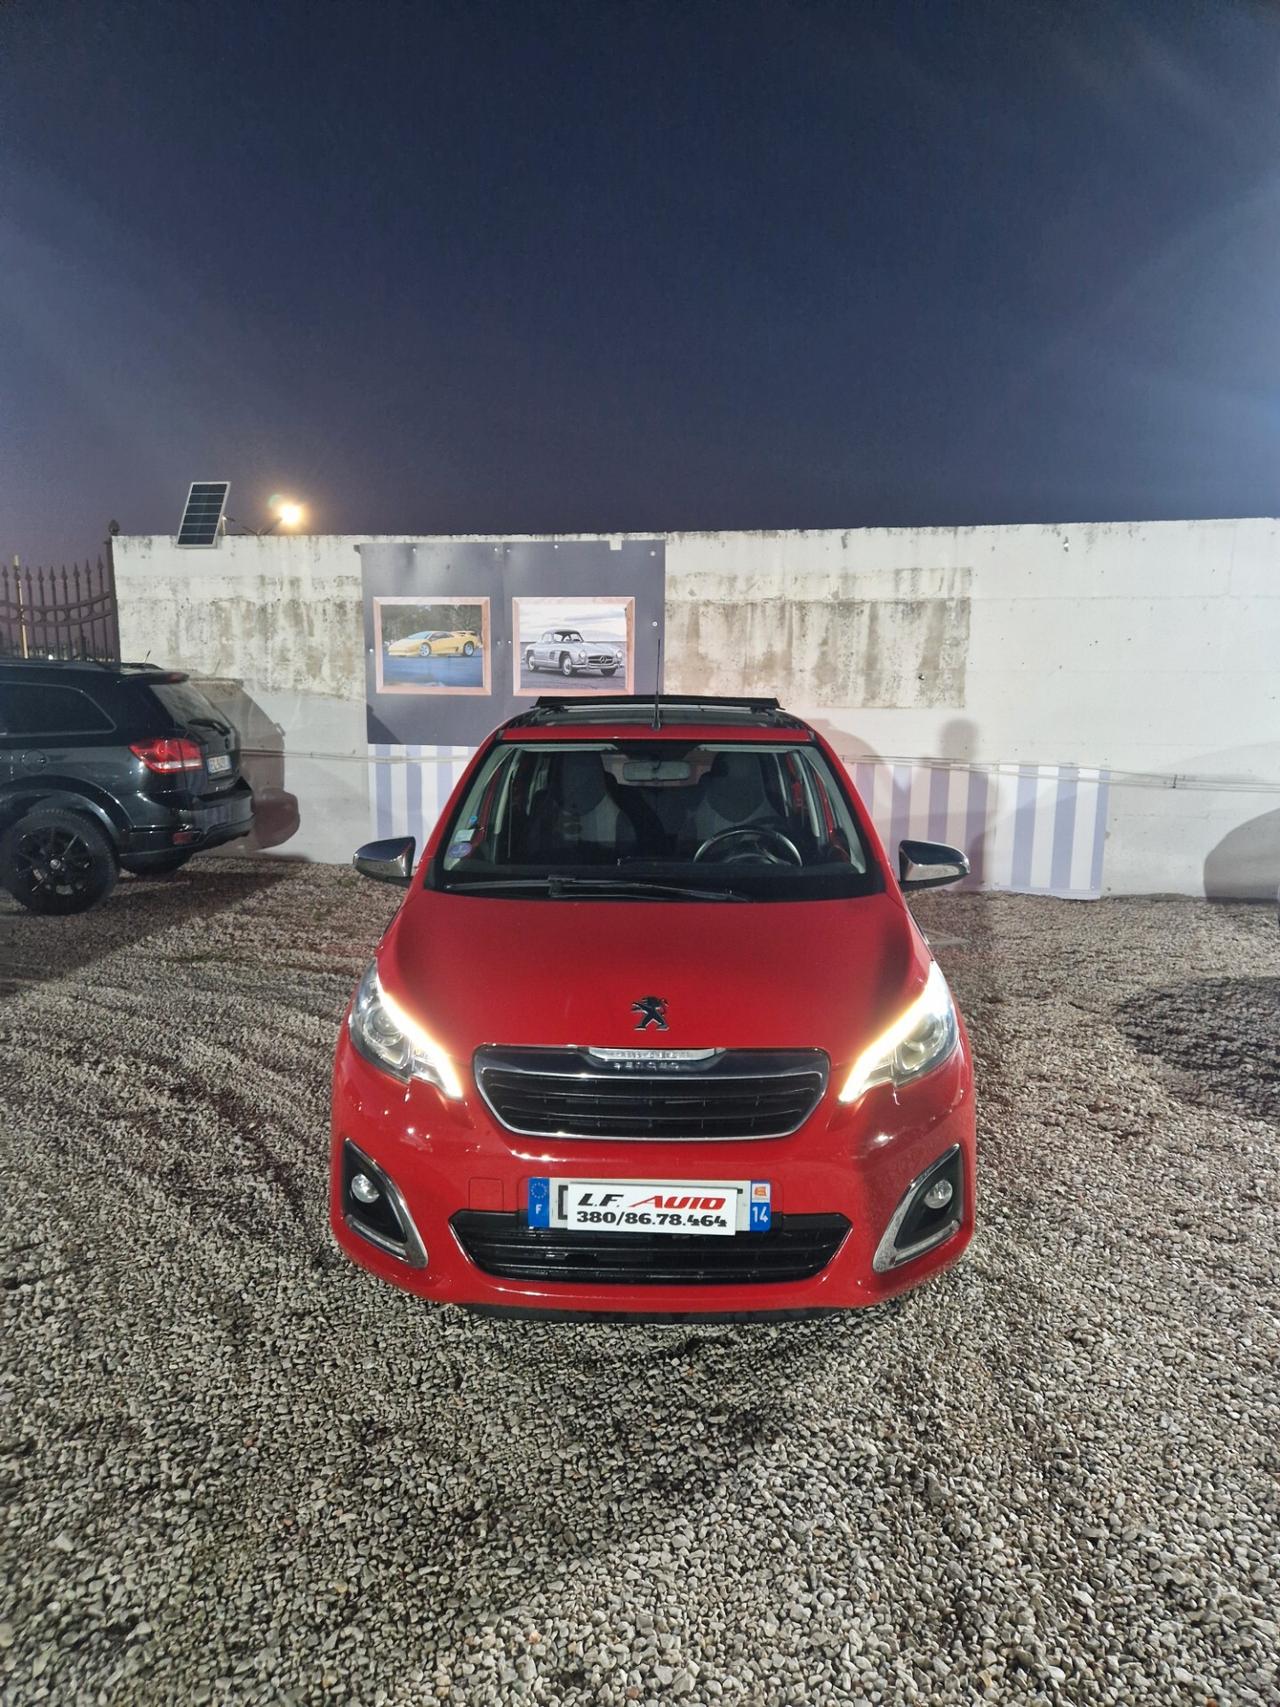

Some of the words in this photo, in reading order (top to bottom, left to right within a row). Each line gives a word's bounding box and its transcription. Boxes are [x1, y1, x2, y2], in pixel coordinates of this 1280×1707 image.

[578, 1193, 625, 1208] L.F.
[535, 1204, 543, 1215] F
[752, 1206, 769, 1223] 14
[576, 1211, 727, 1228] 380/86.78.464
